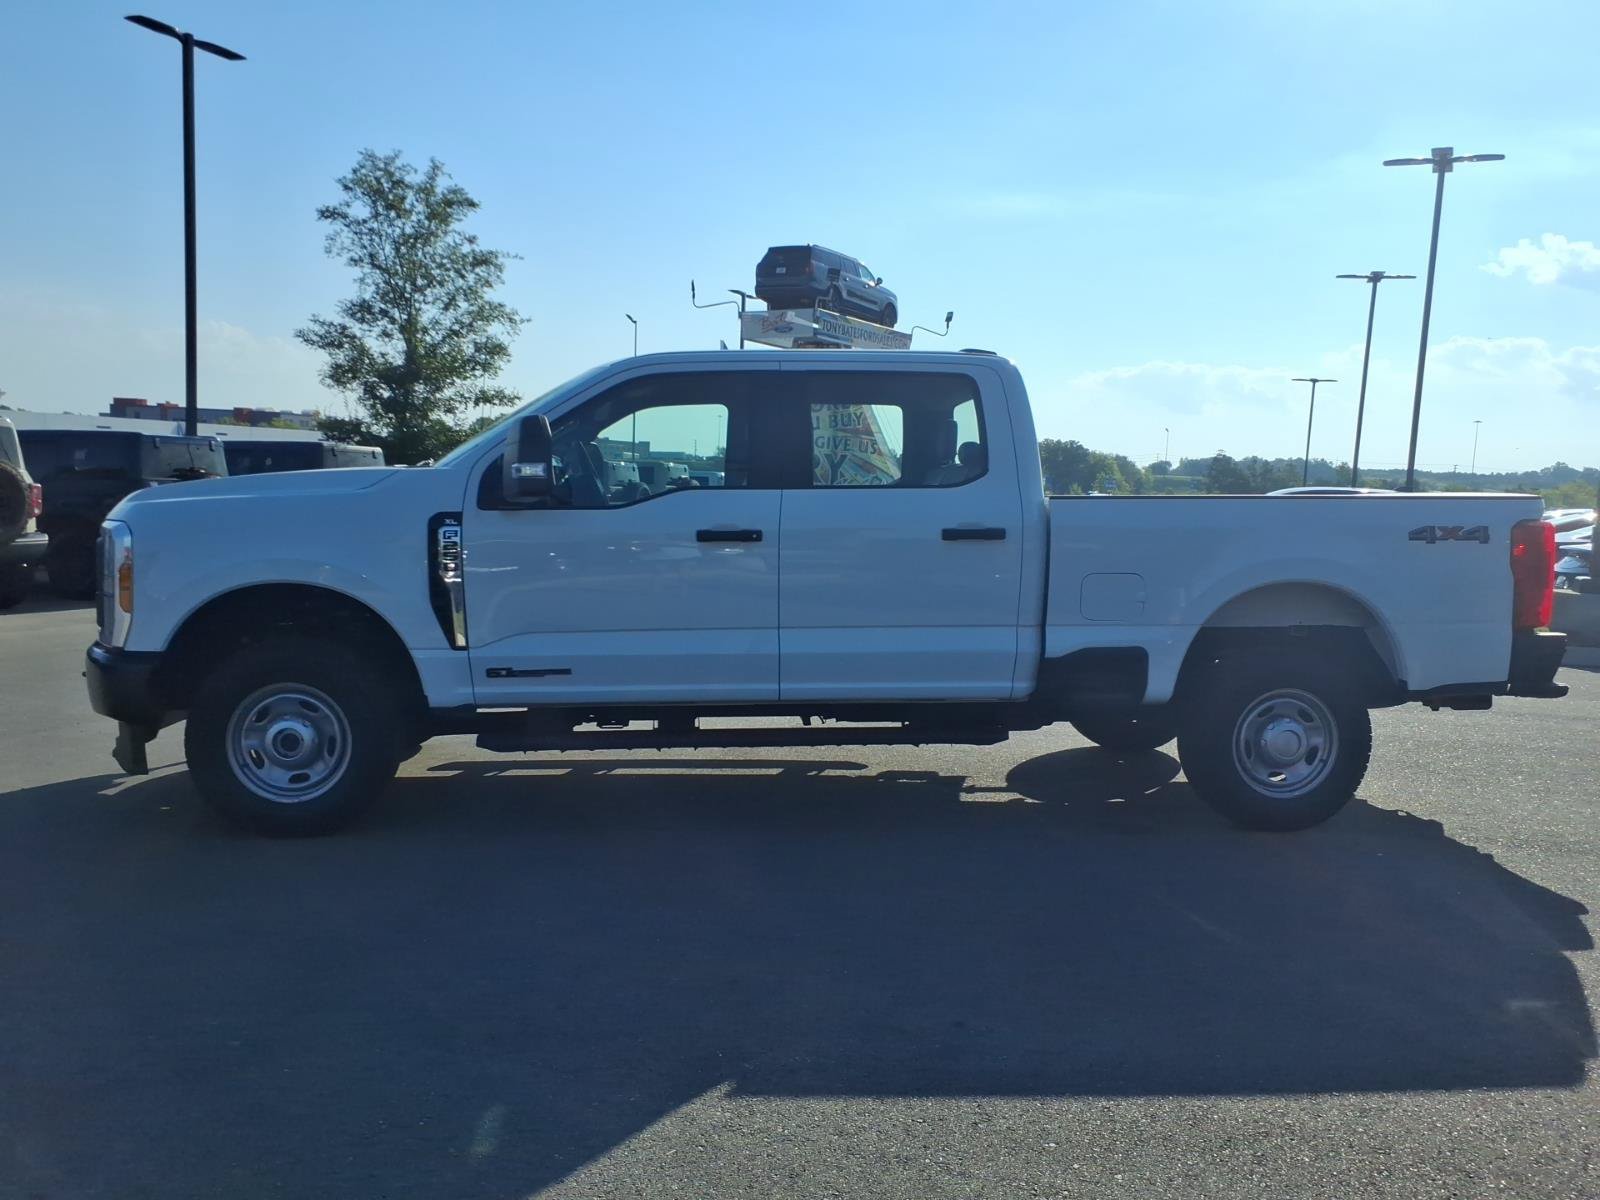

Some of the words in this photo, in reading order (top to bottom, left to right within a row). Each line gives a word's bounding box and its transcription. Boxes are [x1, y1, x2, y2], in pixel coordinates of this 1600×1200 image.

[828, 411, 865, 429] BUY
[814, 435, 851, 452] GIVE
[858, 439, 878, 455] US
